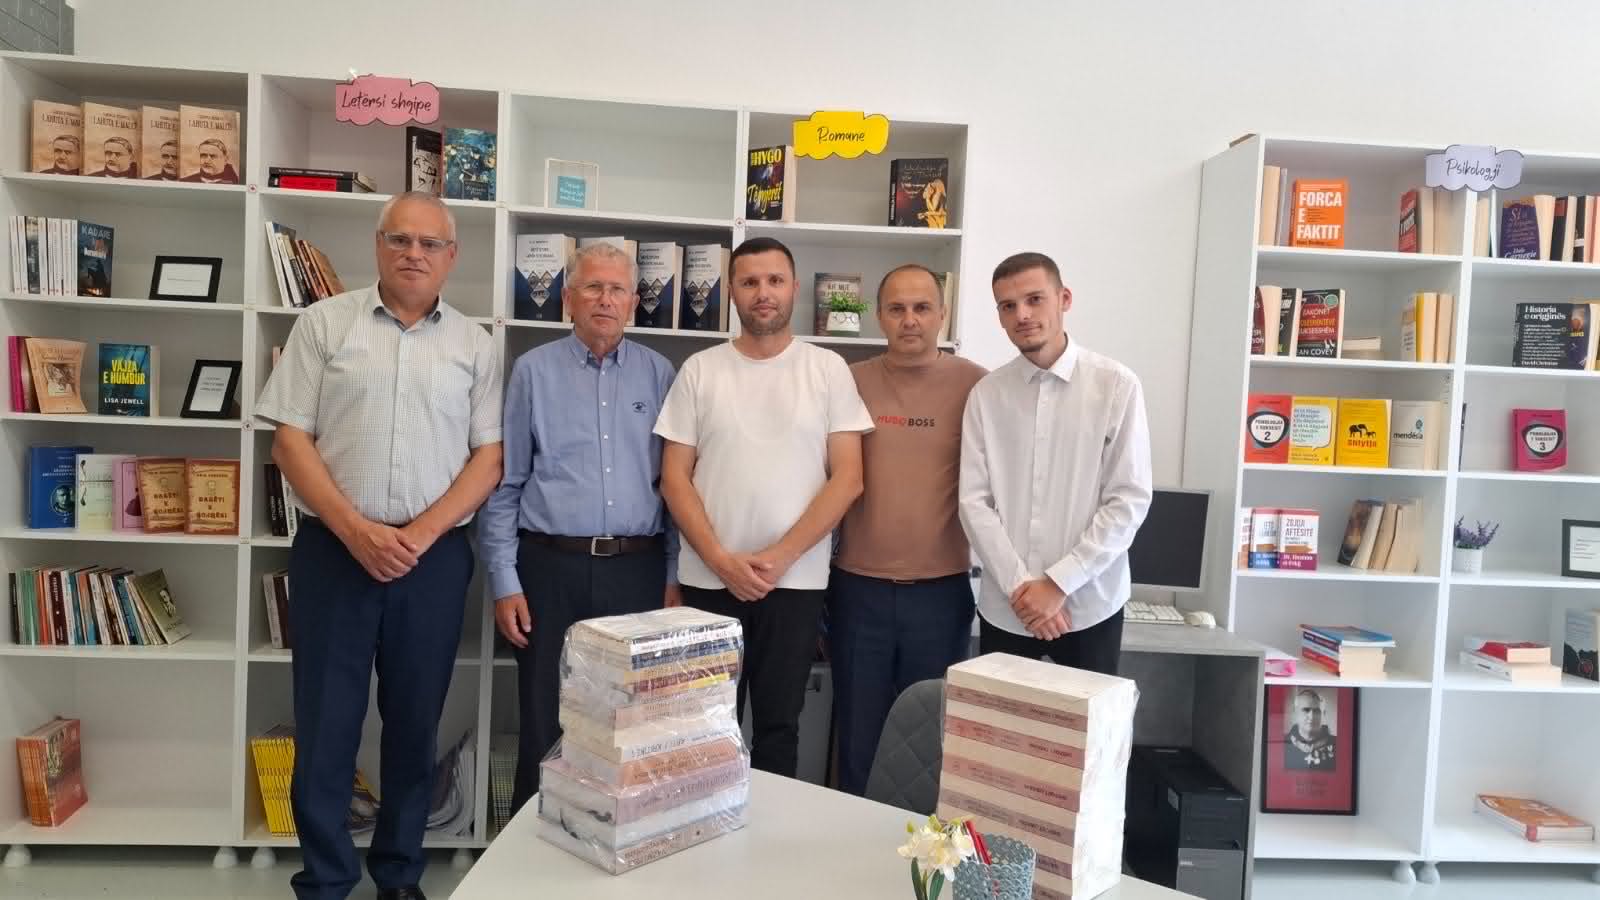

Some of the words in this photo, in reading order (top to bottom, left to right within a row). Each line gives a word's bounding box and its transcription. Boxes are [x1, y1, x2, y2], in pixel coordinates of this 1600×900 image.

[341, 90, 386, 109] Letërsi
[391, 91, 432, 116] shqipe
[817, 126, 865, 144] Romane
[1446, 158, 1501, 182] Psikologji
[1299, 192, 1342, 207] FORCA
[1298, 208, 1305, 223] E
[81, 225, 112, 240] KADARE
[1296, 224, 1341, 240] FAKTIT
[1310, 348, 1334, 356] COVEY
[111, 360, 137, 372] VAJZA
[907, 418, 936, 427] BOSS
[1264, 431, 1271, 441] 2
[1539, 442, 1546, 451] 3
